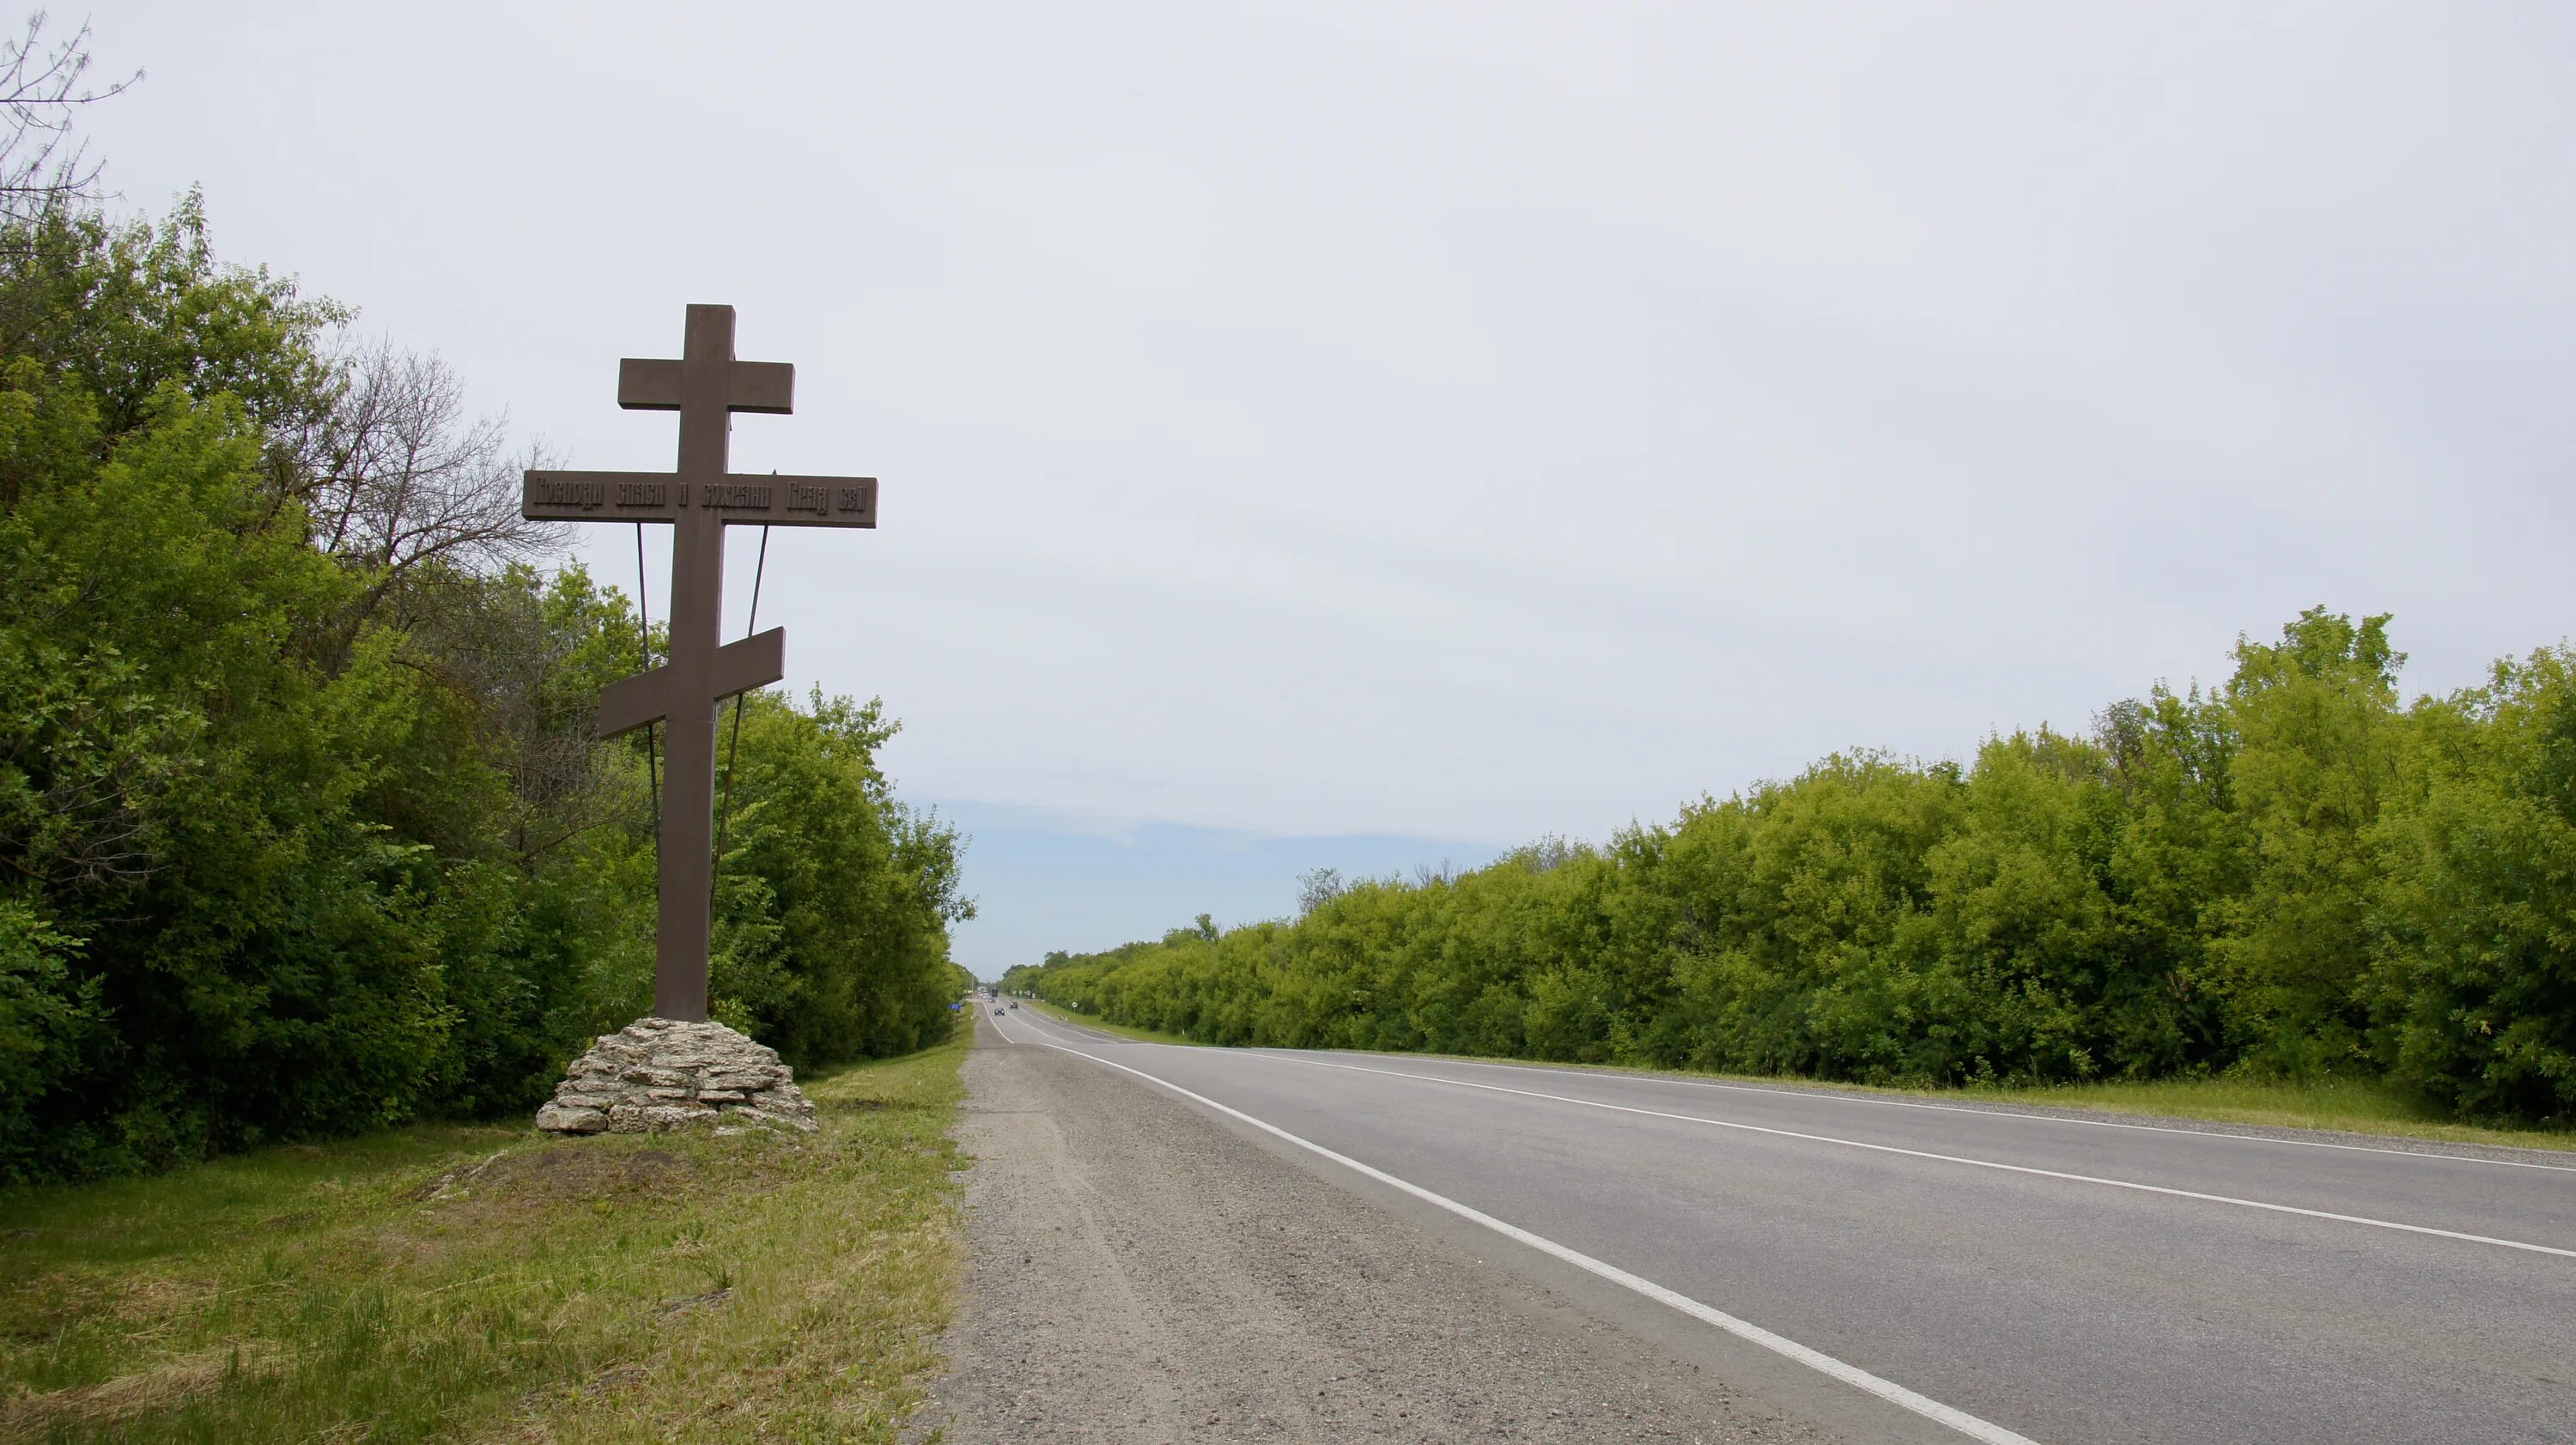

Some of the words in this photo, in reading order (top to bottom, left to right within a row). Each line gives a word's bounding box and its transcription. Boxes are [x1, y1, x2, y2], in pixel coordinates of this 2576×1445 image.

[617, 483, 665, 507] спаси
[678, 482, 687, 507] и
[702, 483, 771, 508] сохрани
[787, 481, 829, 514] Град
